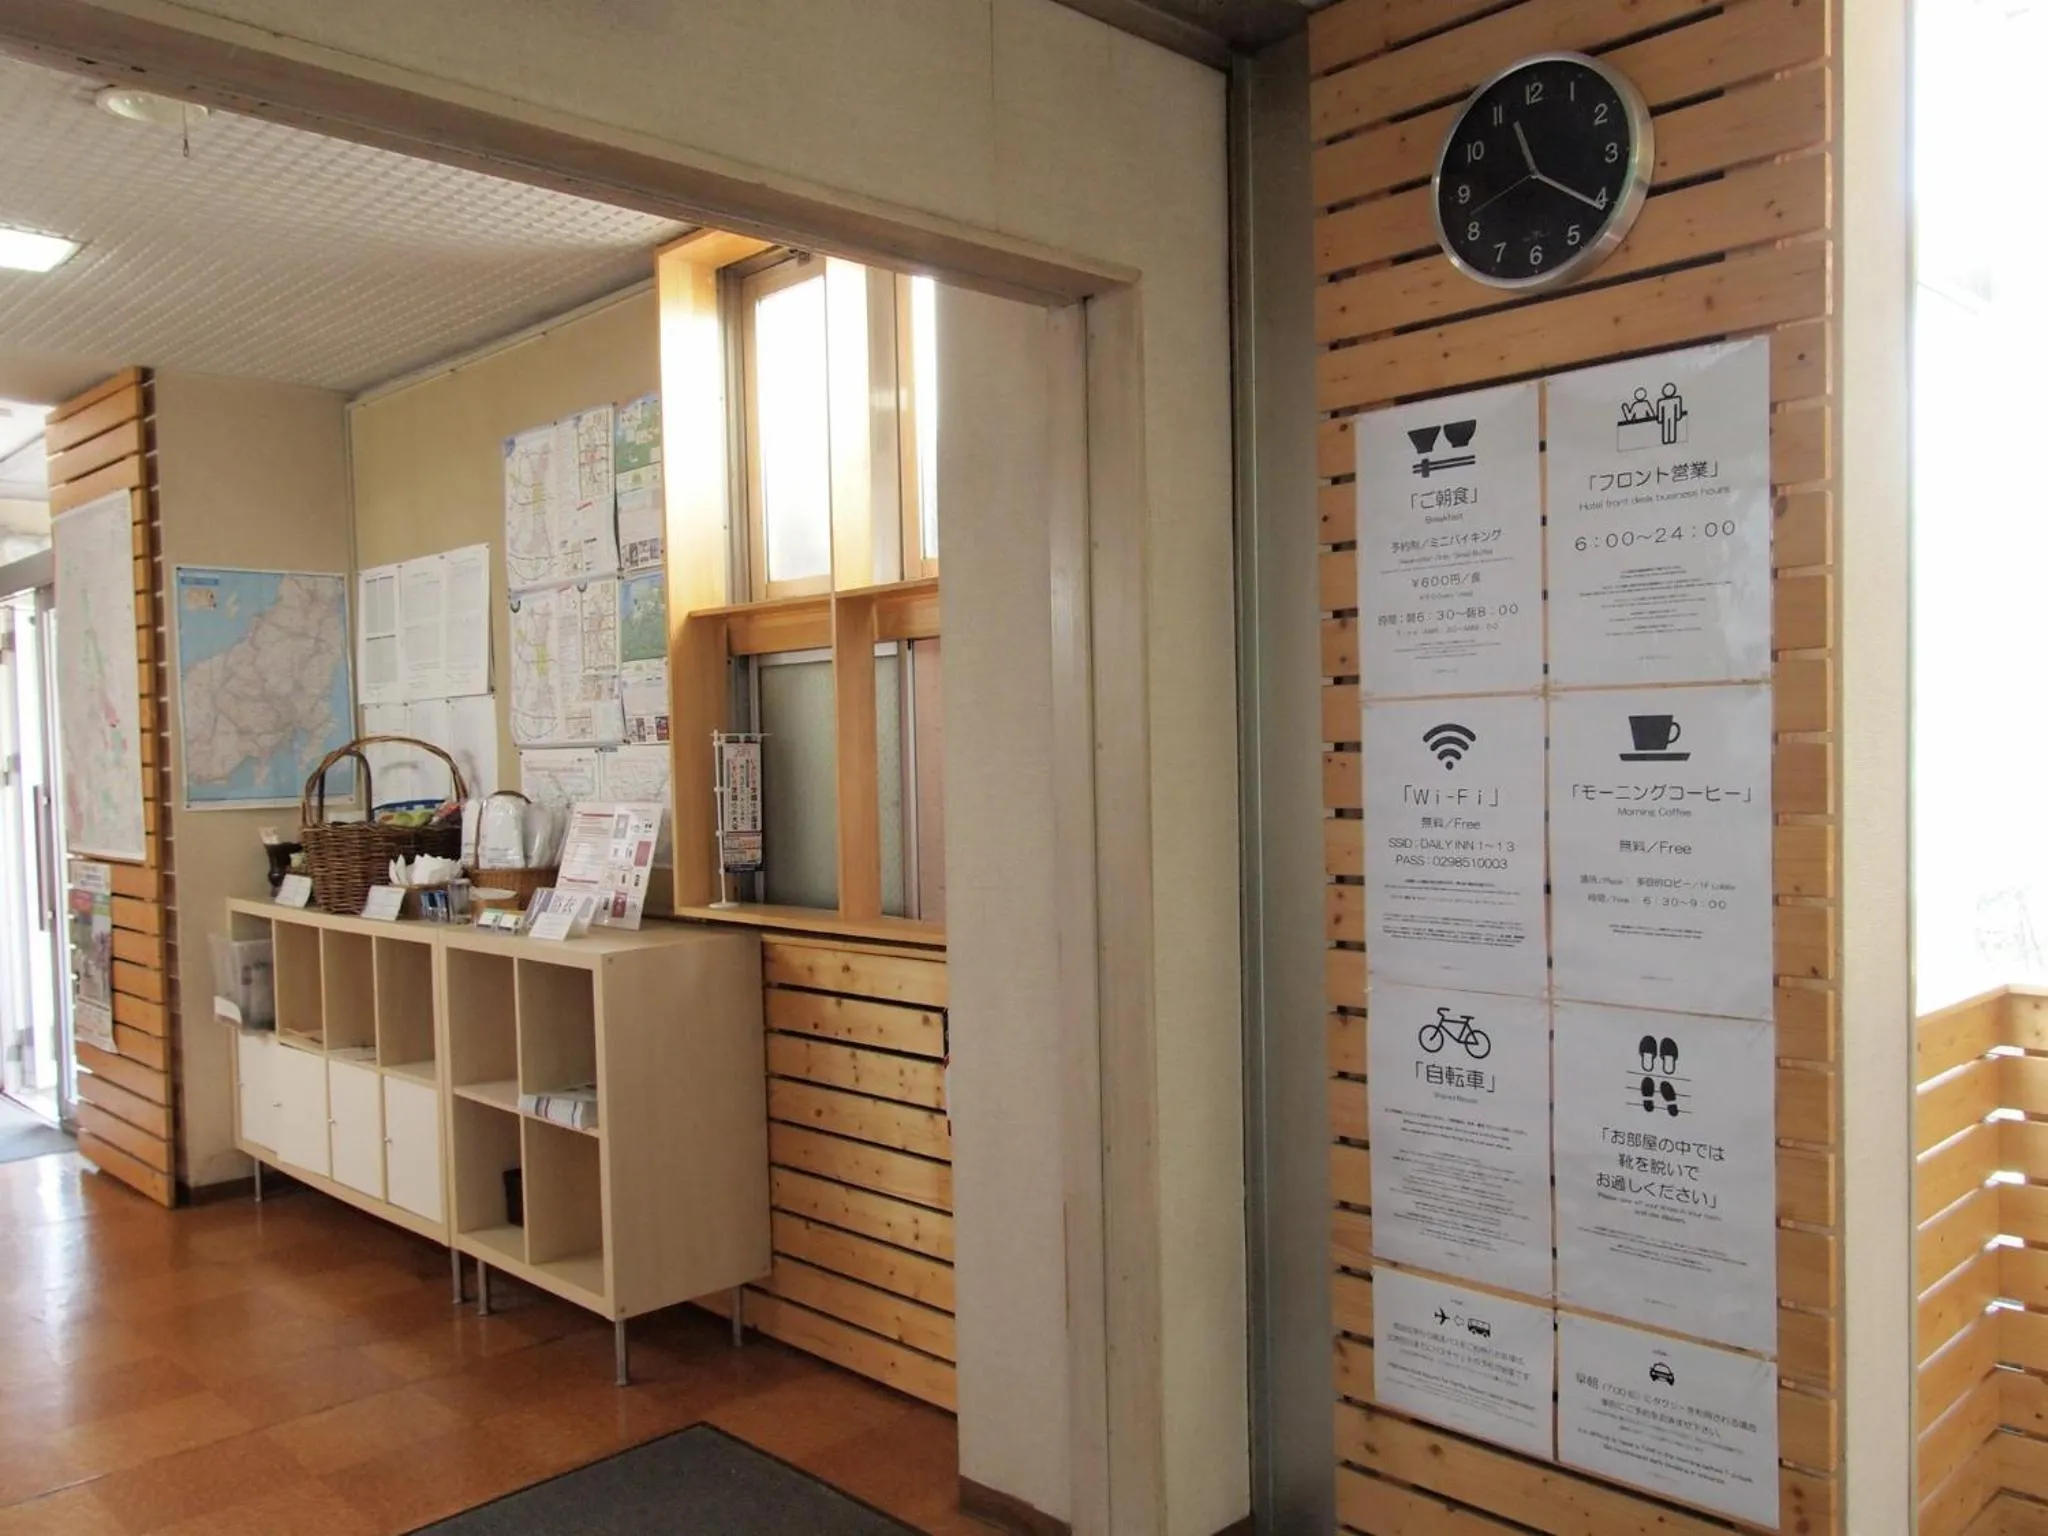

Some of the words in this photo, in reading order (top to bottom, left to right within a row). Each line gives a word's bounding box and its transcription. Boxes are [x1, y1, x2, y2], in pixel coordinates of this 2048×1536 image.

[1525, 82, 1544, 105] 12
[1569, 81, 1575, 101] 1
[1492, 105, 1503, 127] 11
[1593, 103, 1608, 125] 2
[1466, 140, 1485, 163] 10
[1604, 142, 1618, 163] 3
[1457, 184, 1471, 204] 9
[1596, 186, 1608, 208] 4
[1466, 221, 1481, 241] 8
[1567, 225, 1581, 245] 5
[1493, 241, 1507, 263] 7
[1529, 245, 1543, 265] 6
[1589, 460, 1719, 491] 「フロント営業」
[1410, 486, 1478, 511] 「ご朝食」
[1572, 783, 1752, 803] 「モーニングコーヒー」
[1415, 1060, 1495, 1093] 「自転車」
[1602, 1126, 1726, 1162] 「お部屋の中では
[1618, 1153, 1700, 1181] 靴を脱いで
